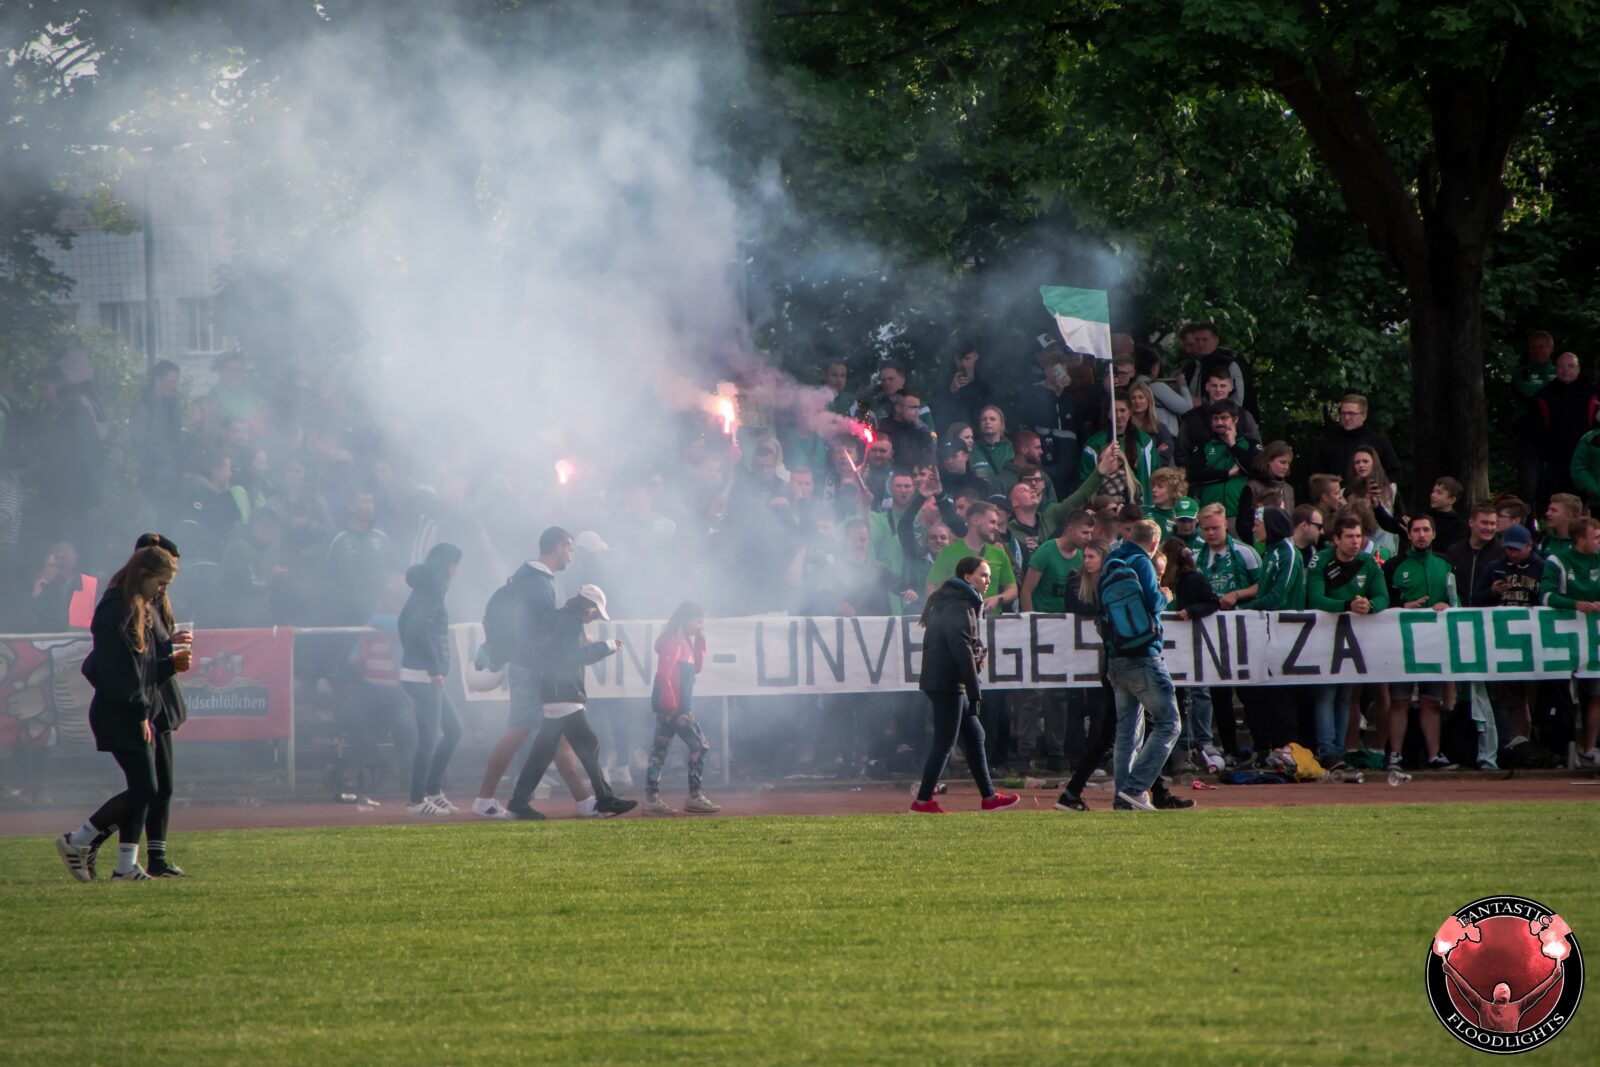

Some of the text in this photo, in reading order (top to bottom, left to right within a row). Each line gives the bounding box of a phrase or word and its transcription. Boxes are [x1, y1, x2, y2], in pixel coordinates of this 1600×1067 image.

[756, 612, 1250, 687] UNVEGESEN!
[1265, 611, 1367, 676] ZA
[185, 693, 267, 711] ldschlößchen
